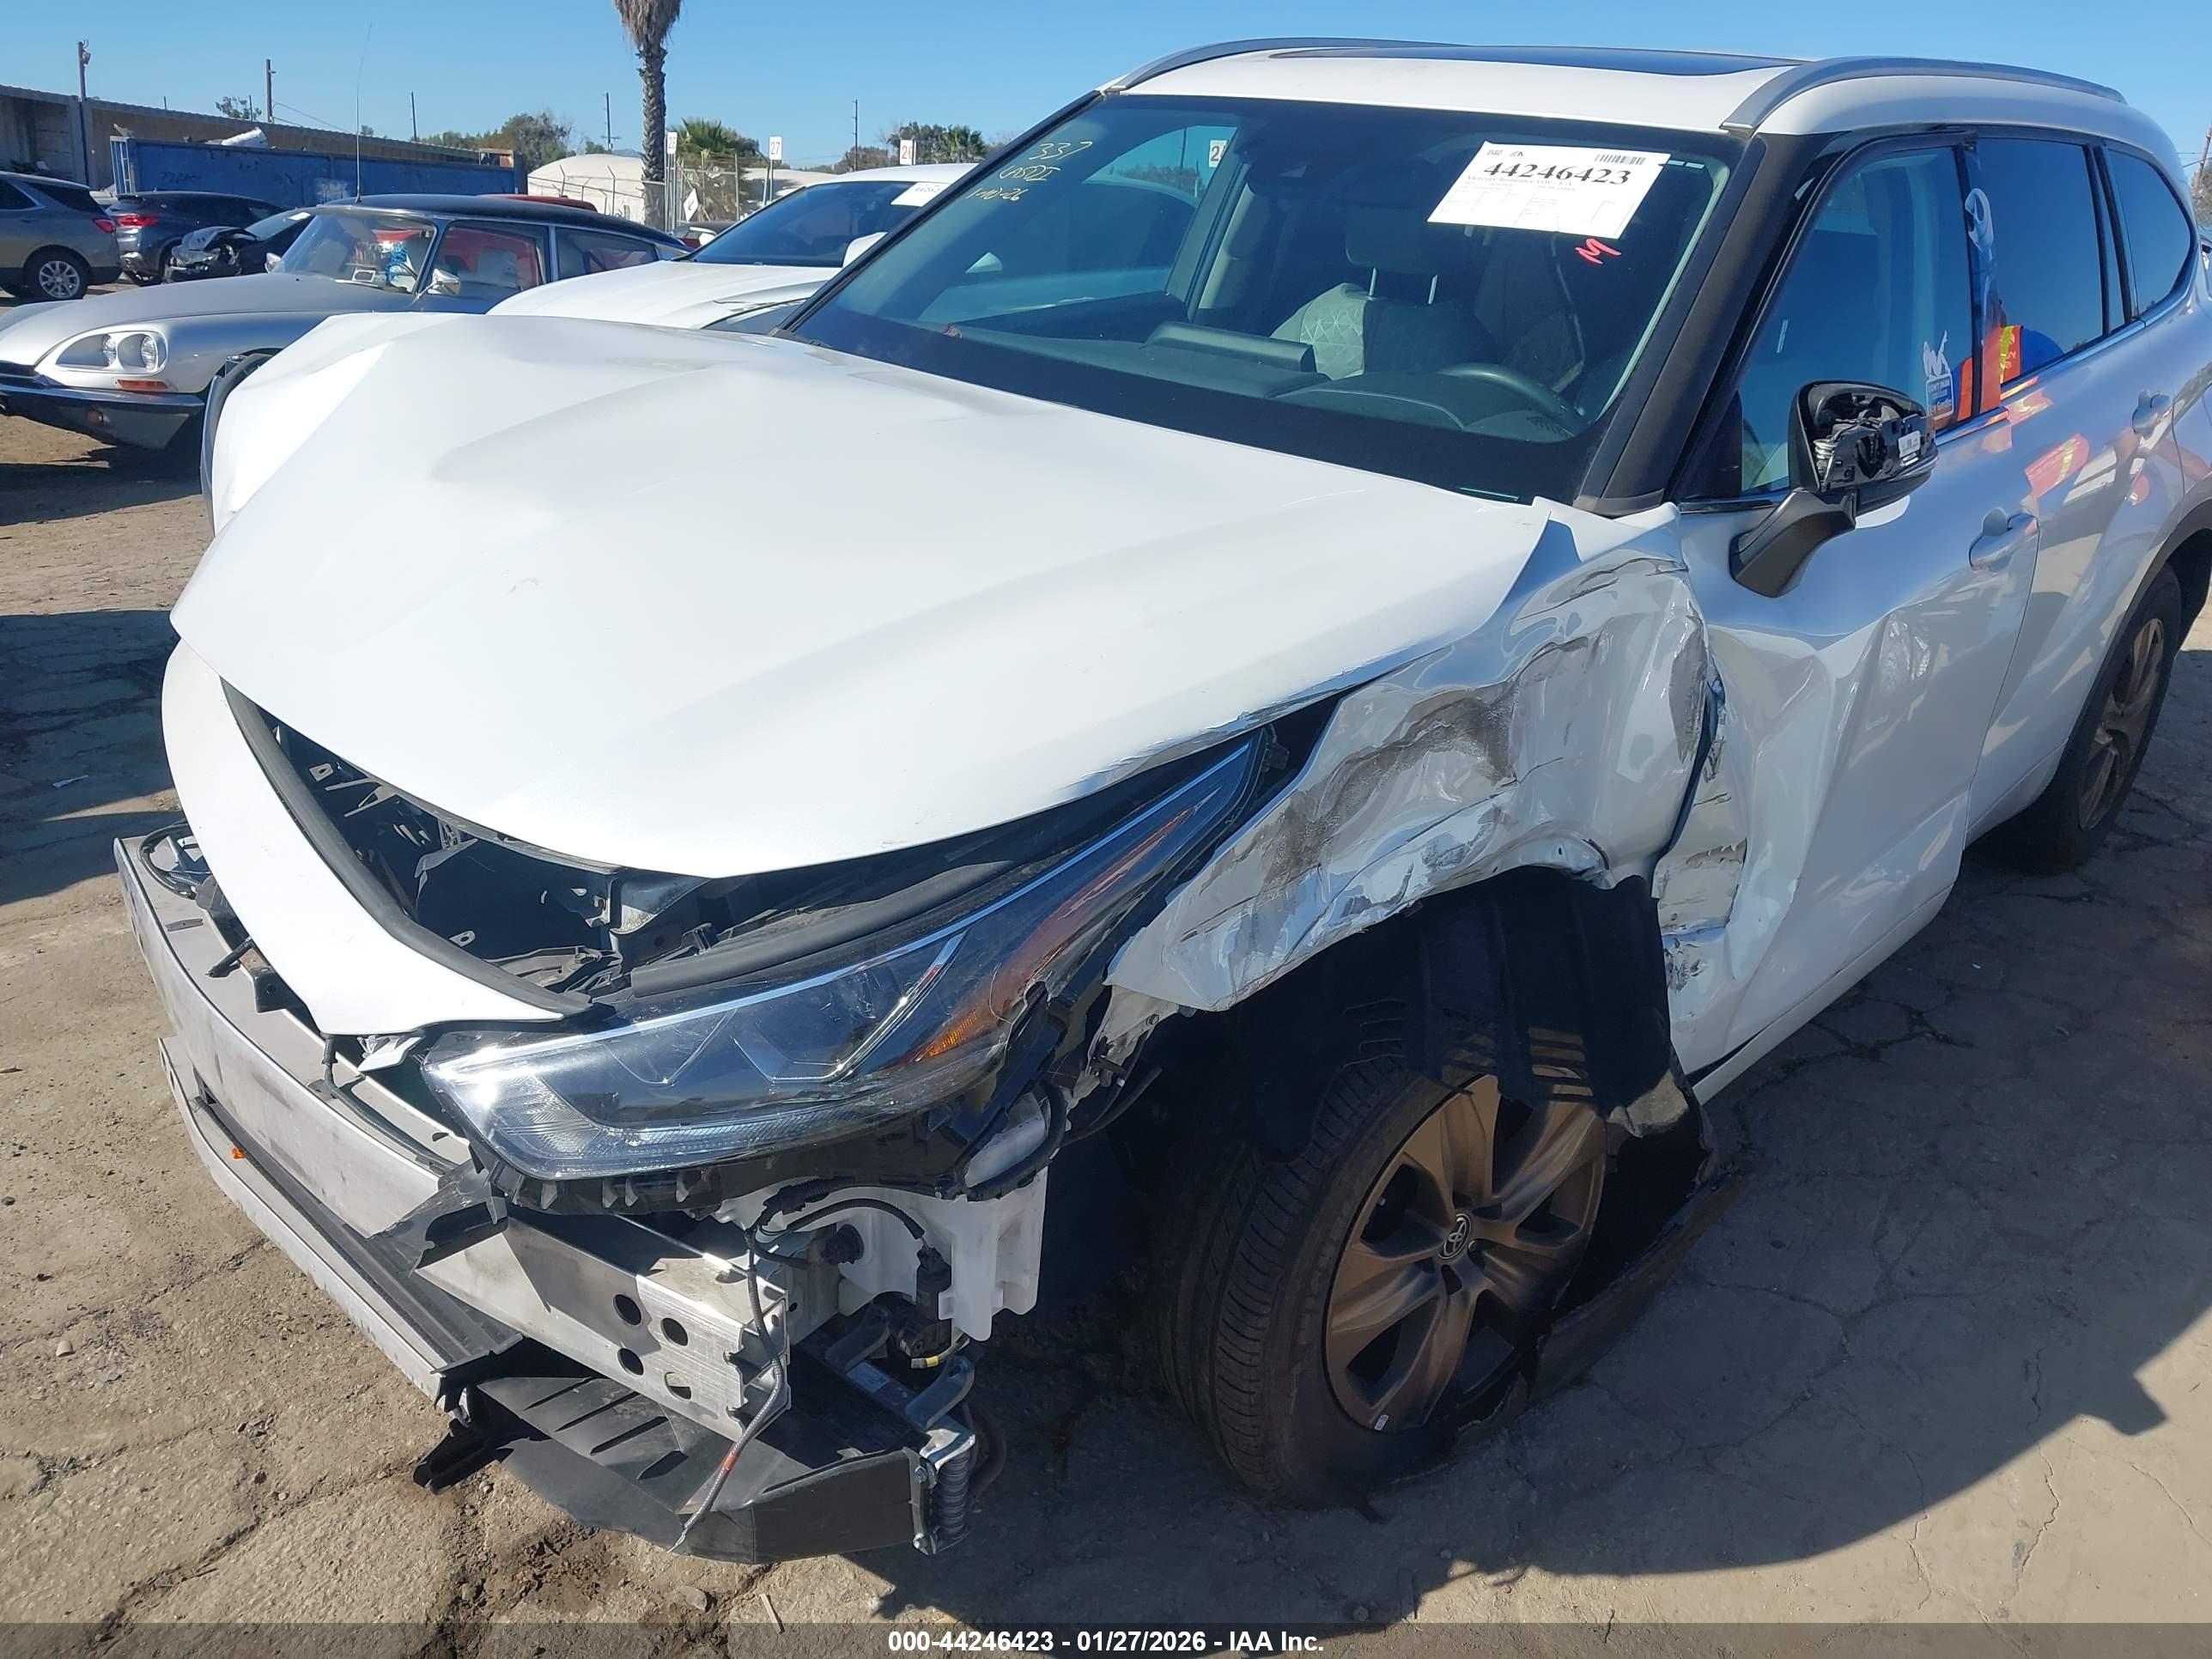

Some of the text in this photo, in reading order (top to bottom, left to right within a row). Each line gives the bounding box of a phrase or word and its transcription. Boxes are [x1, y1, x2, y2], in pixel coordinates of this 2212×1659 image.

[770, 141, 781, 155] 27
[1029, 141, 1093, 161] 337
[1483, 161, 1632, 185] 44246423
